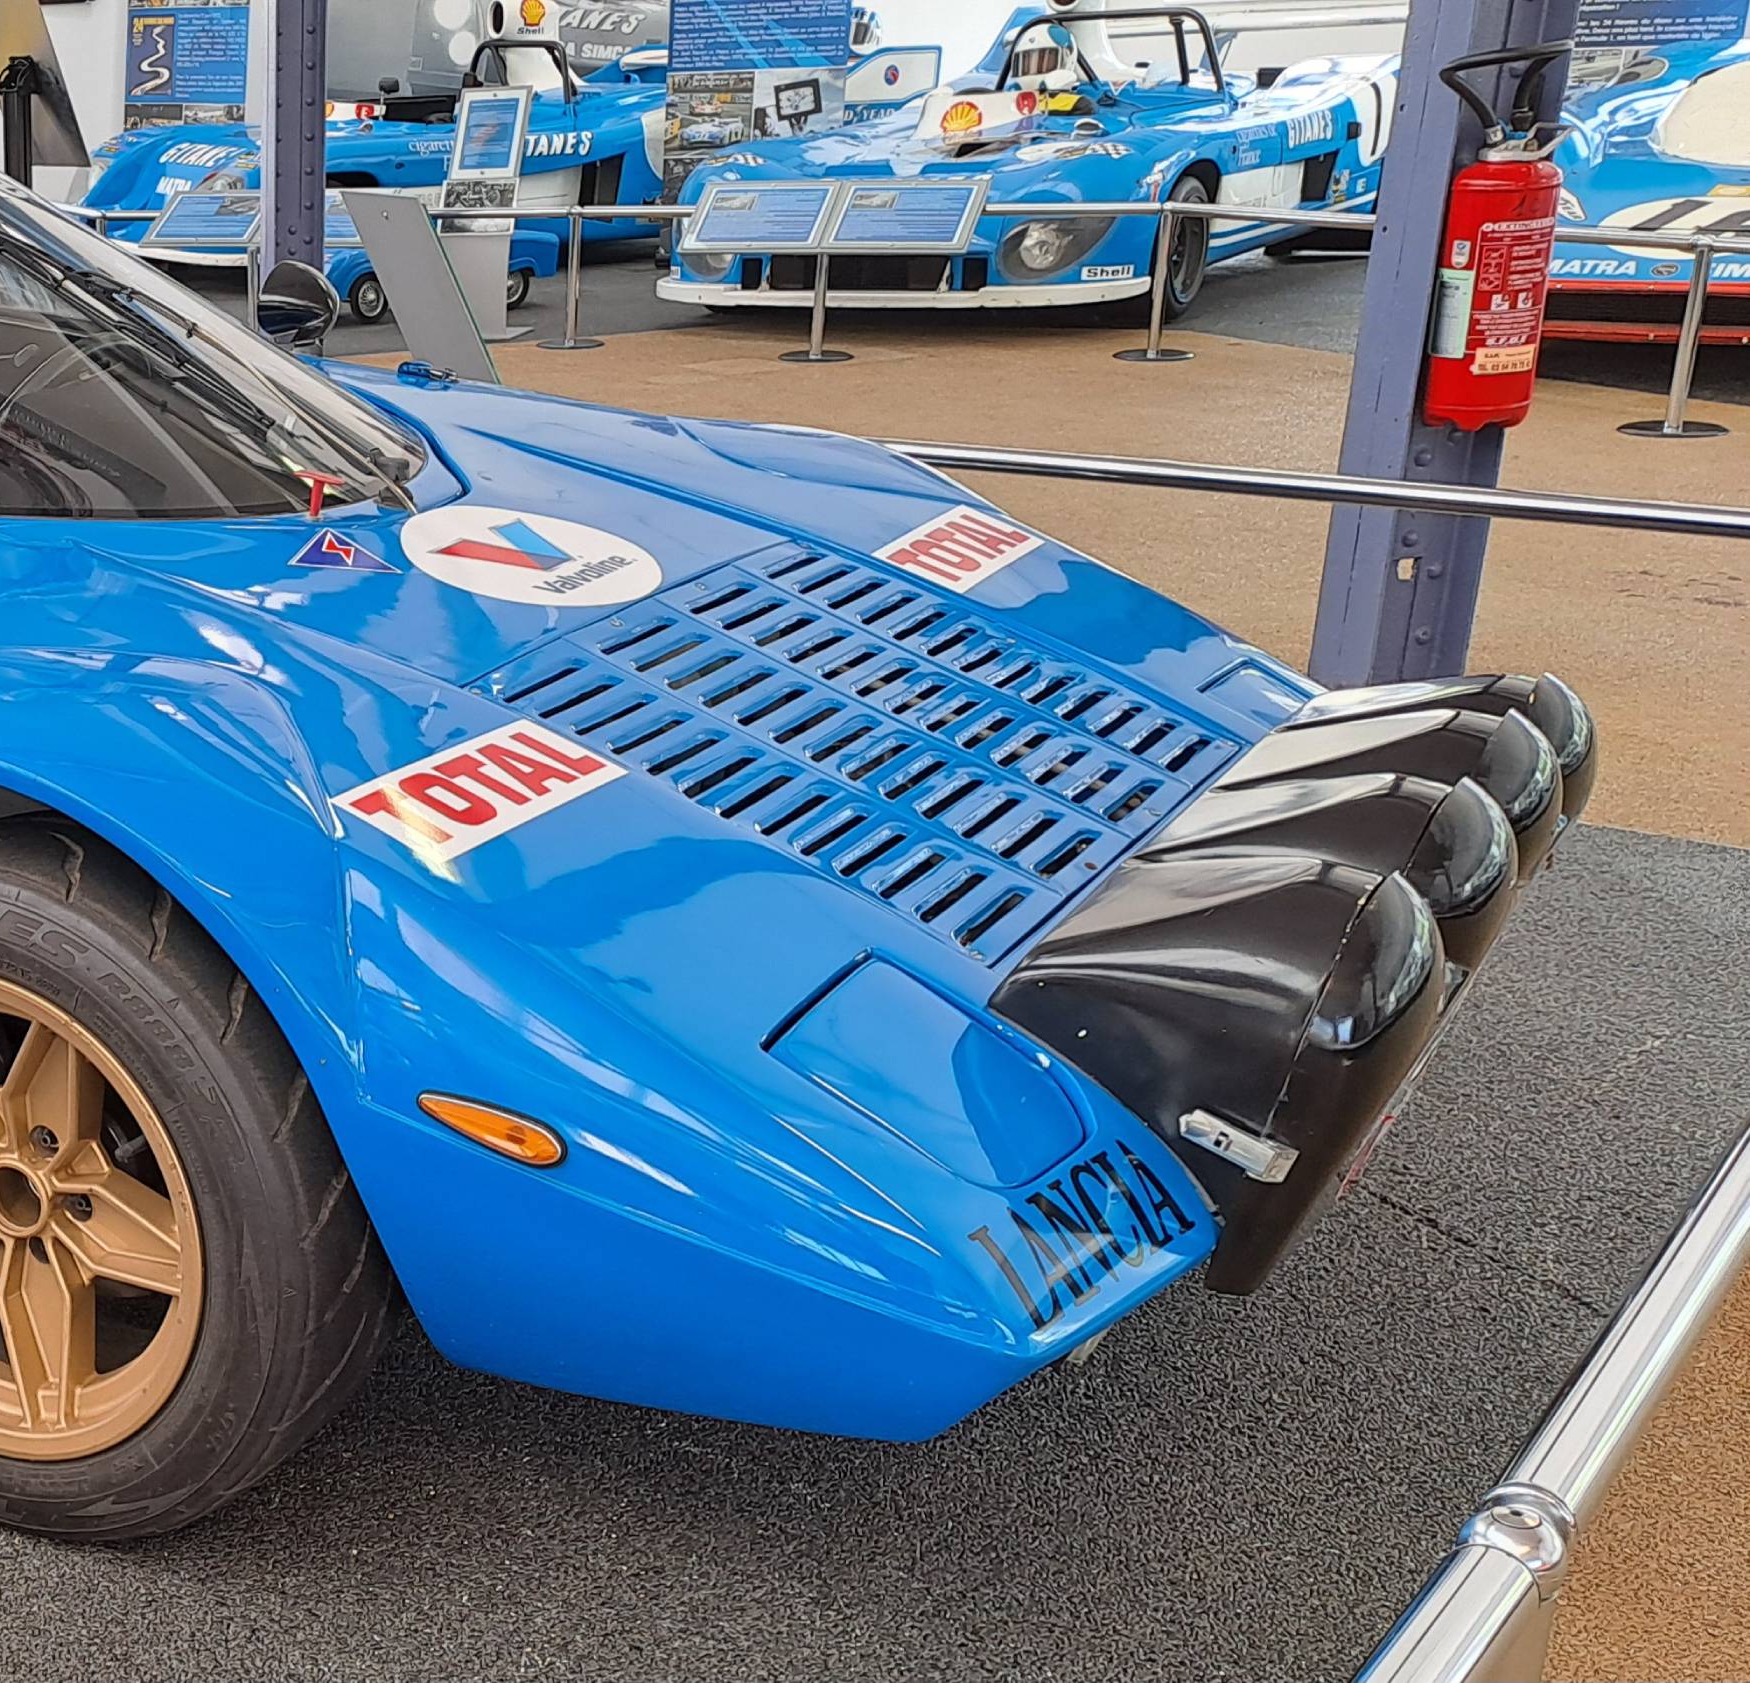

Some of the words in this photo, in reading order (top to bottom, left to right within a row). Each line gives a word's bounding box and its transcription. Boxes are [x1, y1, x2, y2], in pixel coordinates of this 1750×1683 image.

[517, 26, 545, 35] Shell
[1286, 108, 1334, 150] GITANES
[1086, 265, 1131, 278] Shell
[1548, 259, 1637, 277] MATRA
[886, 513, 1032, 583] TOTAL
[531, 552, 633, 595] Valvoline
[348, 731, 608, 844] TOTAL
[967, 1138, 1196, 1332] LANCIA
